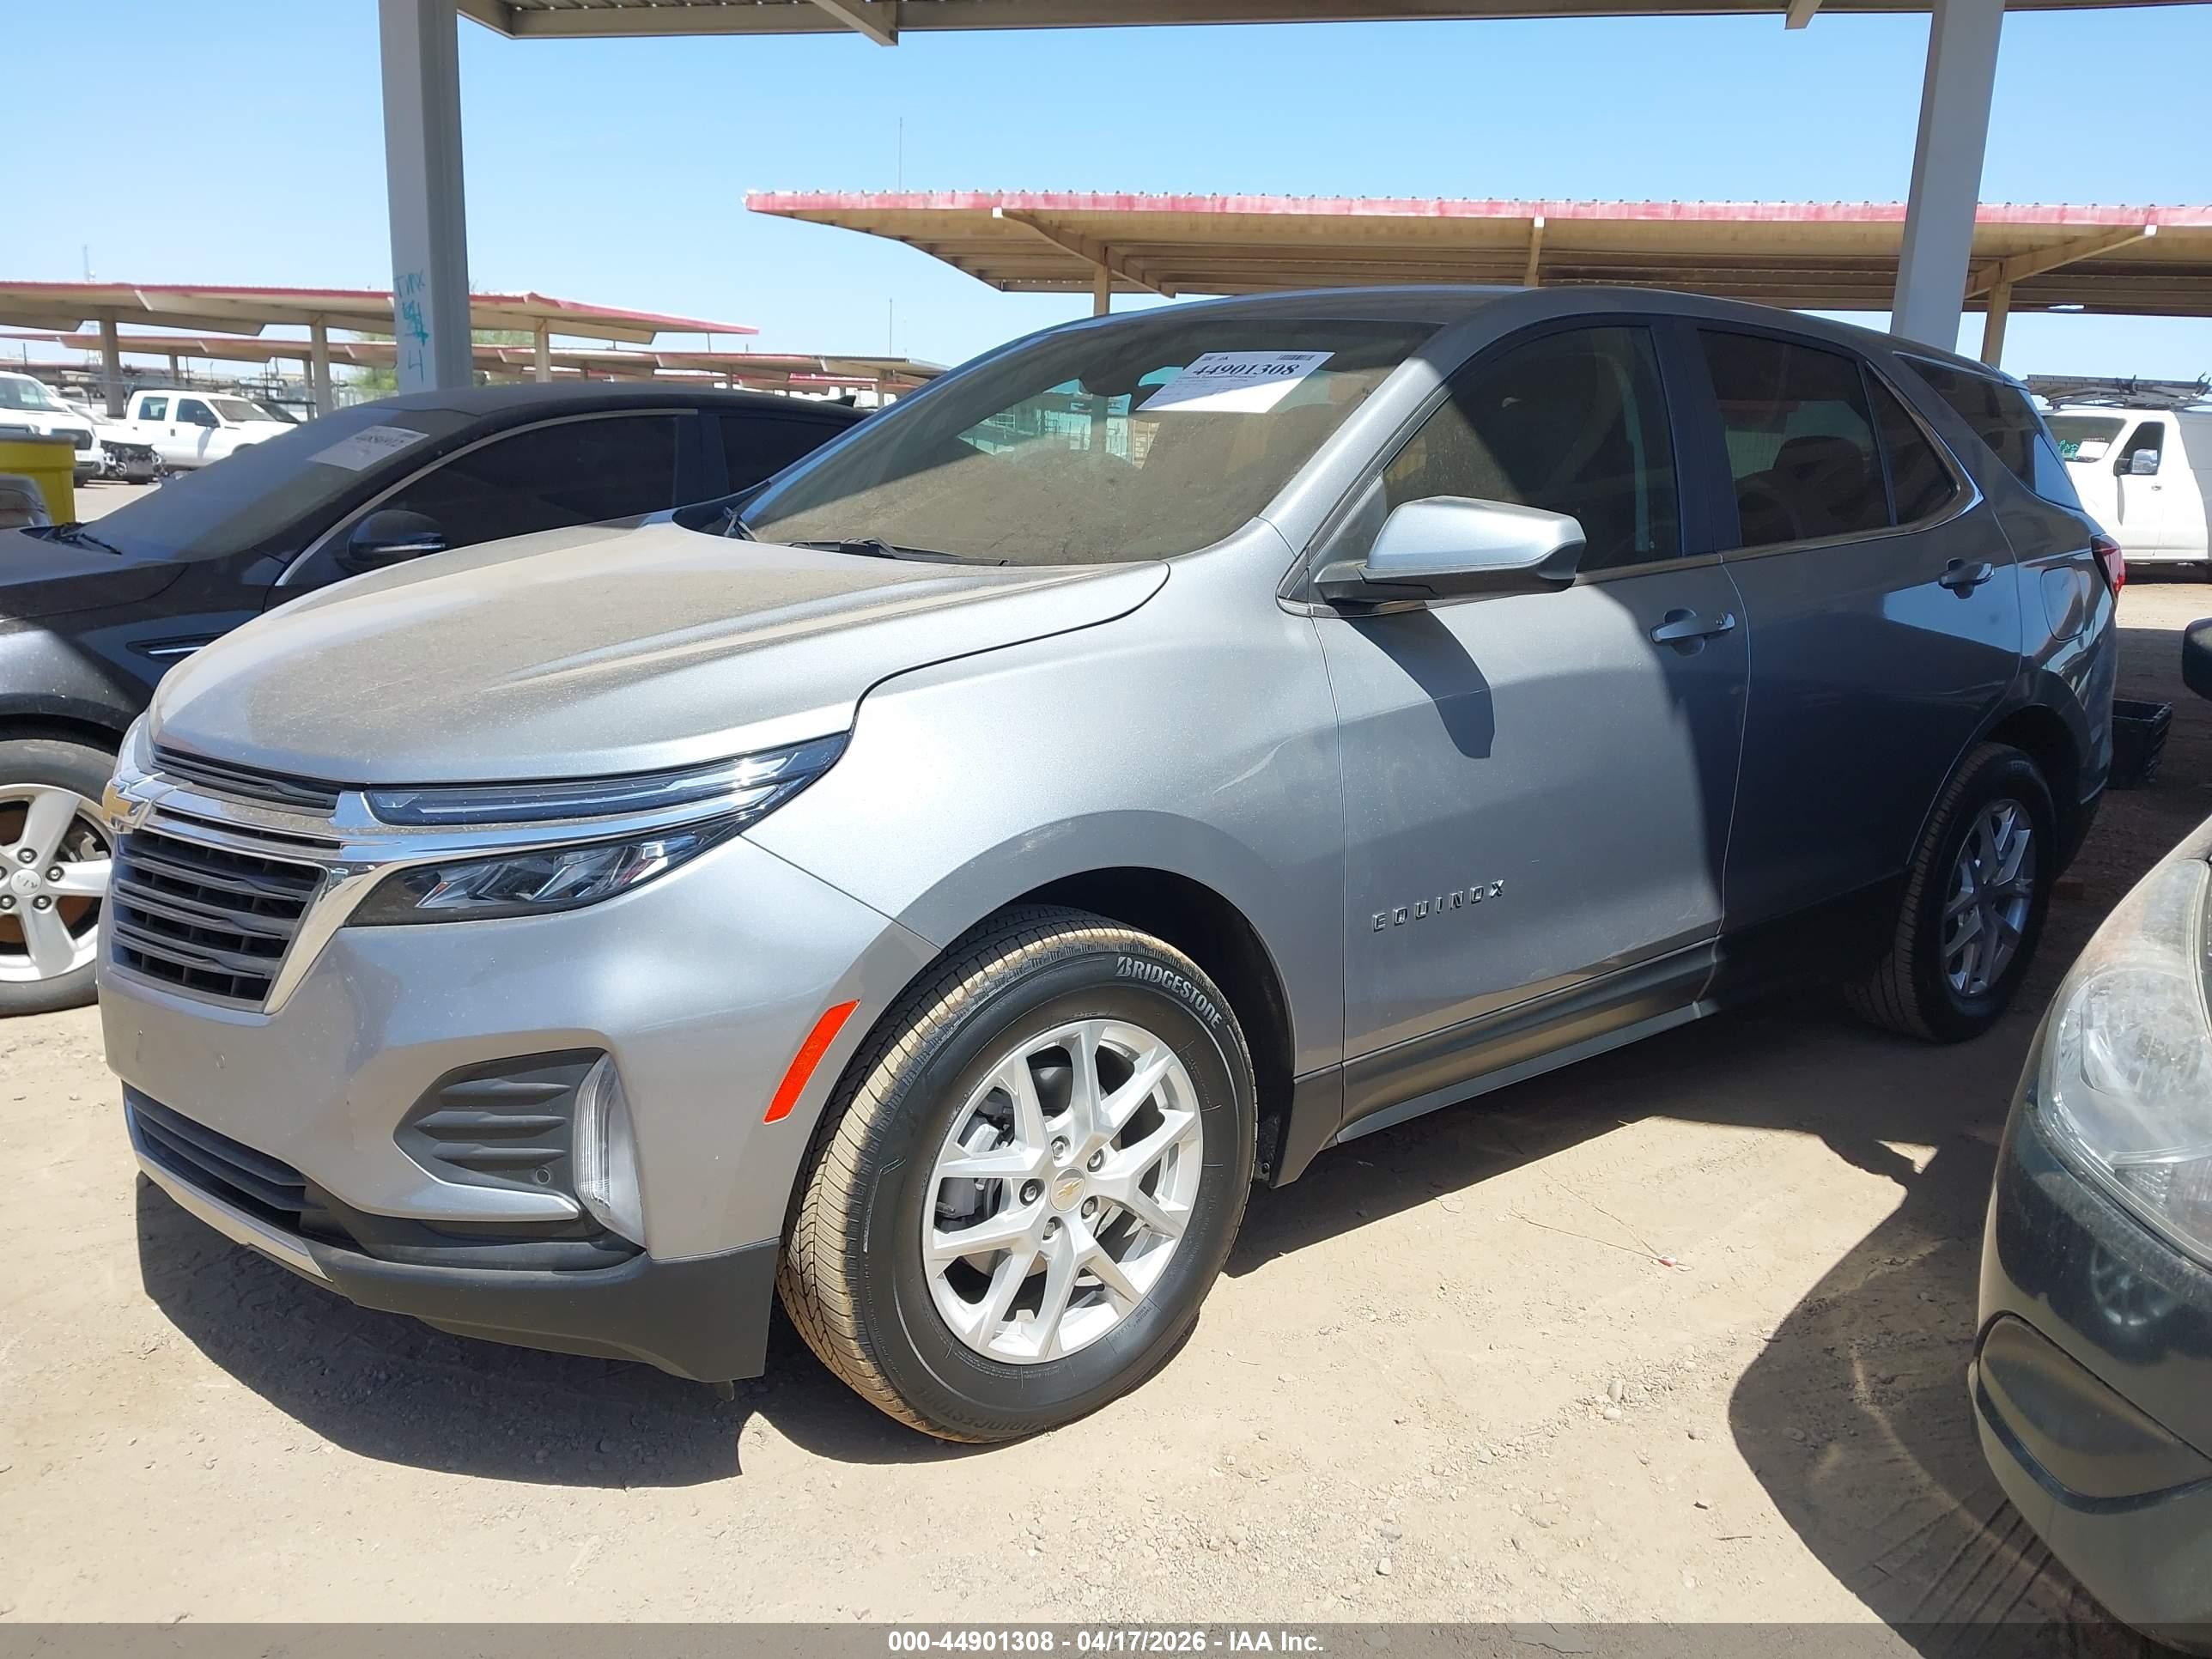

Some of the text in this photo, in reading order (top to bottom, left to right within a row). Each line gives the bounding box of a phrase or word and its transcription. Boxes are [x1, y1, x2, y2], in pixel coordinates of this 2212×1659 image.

[1193, 363, 1299, 376] 44901308
[1372, 879, 1504, 933] EQUINOX
[1115, 956, 1224, 1030] BRIDGESTONE
